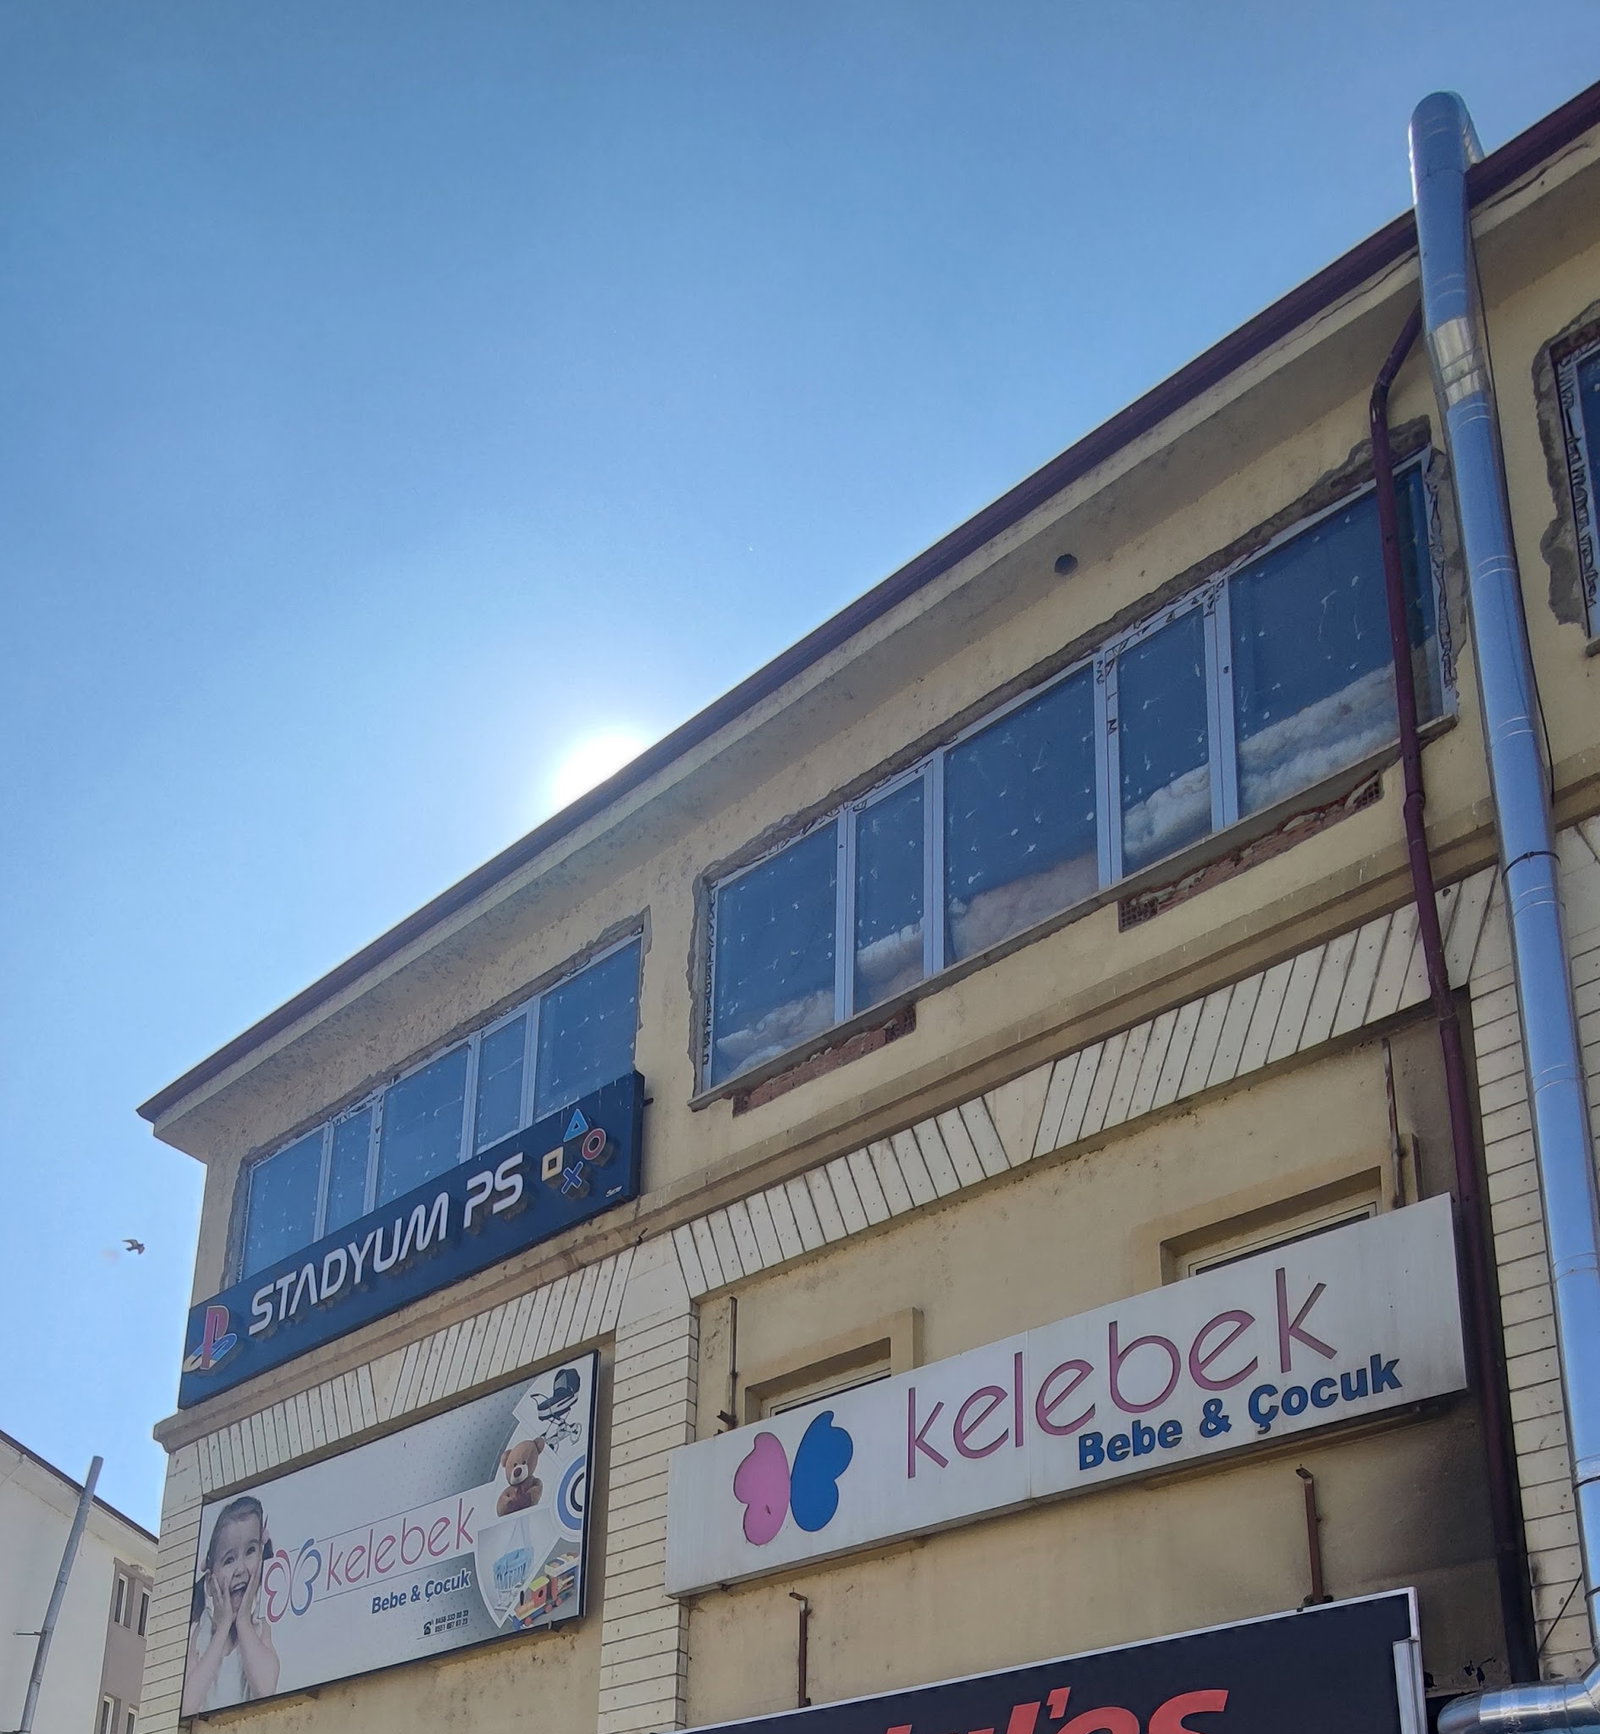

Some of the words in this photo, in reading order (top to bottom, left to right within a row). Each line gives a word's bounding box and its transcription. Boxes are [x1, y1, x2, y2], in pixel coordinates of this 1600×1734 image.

[249, 1192, 449, 1335] STADYUM
[464, 1152, 523, 1229] PS
[907, 1267, 1337, 1479] kelebek
[1079, 1417, 1183, 1471] Bebe
[1200, 1399, 1233, 1438] &
[1248, 1354, 1403, 1434] Çocuk
[327, 1498, 475, 1591] kelebek
[372, 1592, 407, 1614] Bebe
[410, 1584, 421, 1602] &
[425, 1569, 471, 1602] Çocuk
